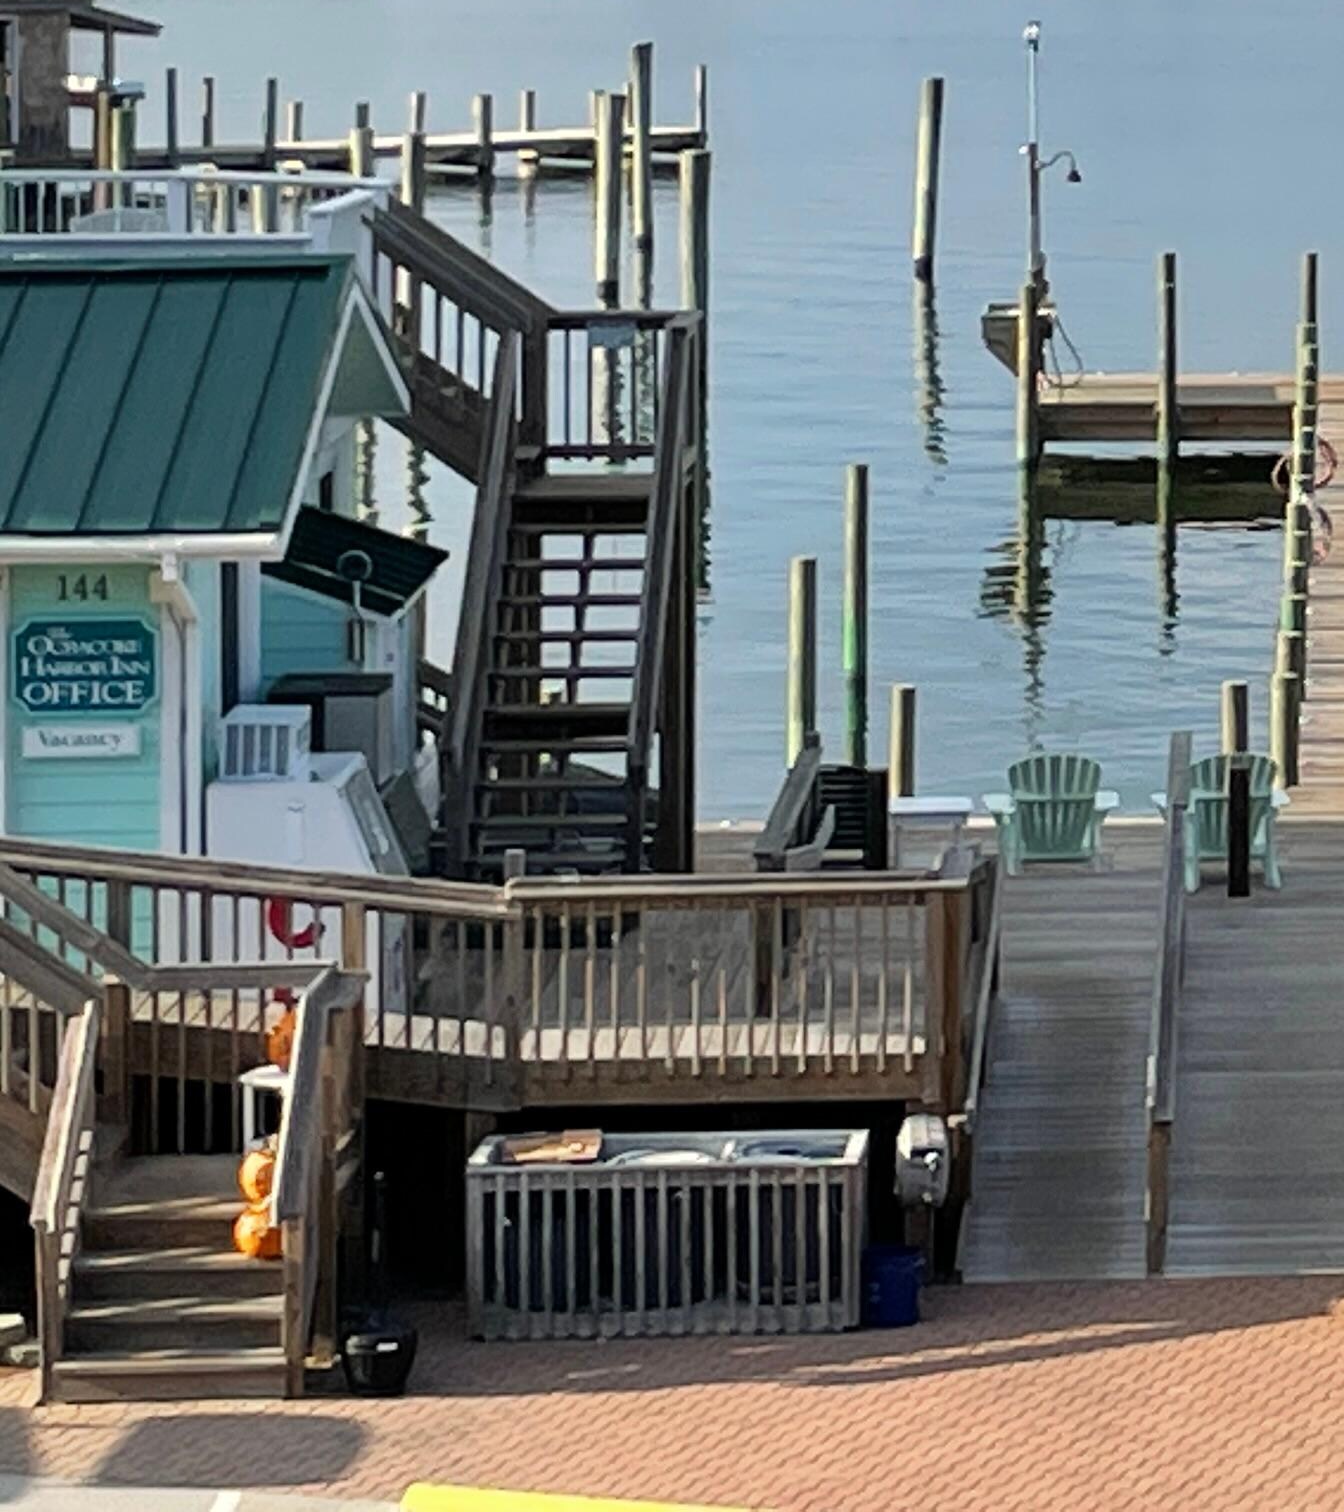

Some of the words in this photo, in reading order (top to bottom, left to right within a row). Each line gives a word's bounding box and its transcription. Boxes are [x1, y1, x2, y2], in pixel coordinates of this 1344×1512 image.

[57, 573, 109, 601] 144
[22, 680, 145, 705] OFFICE
[38, 730, 122, 751] Vacancy
